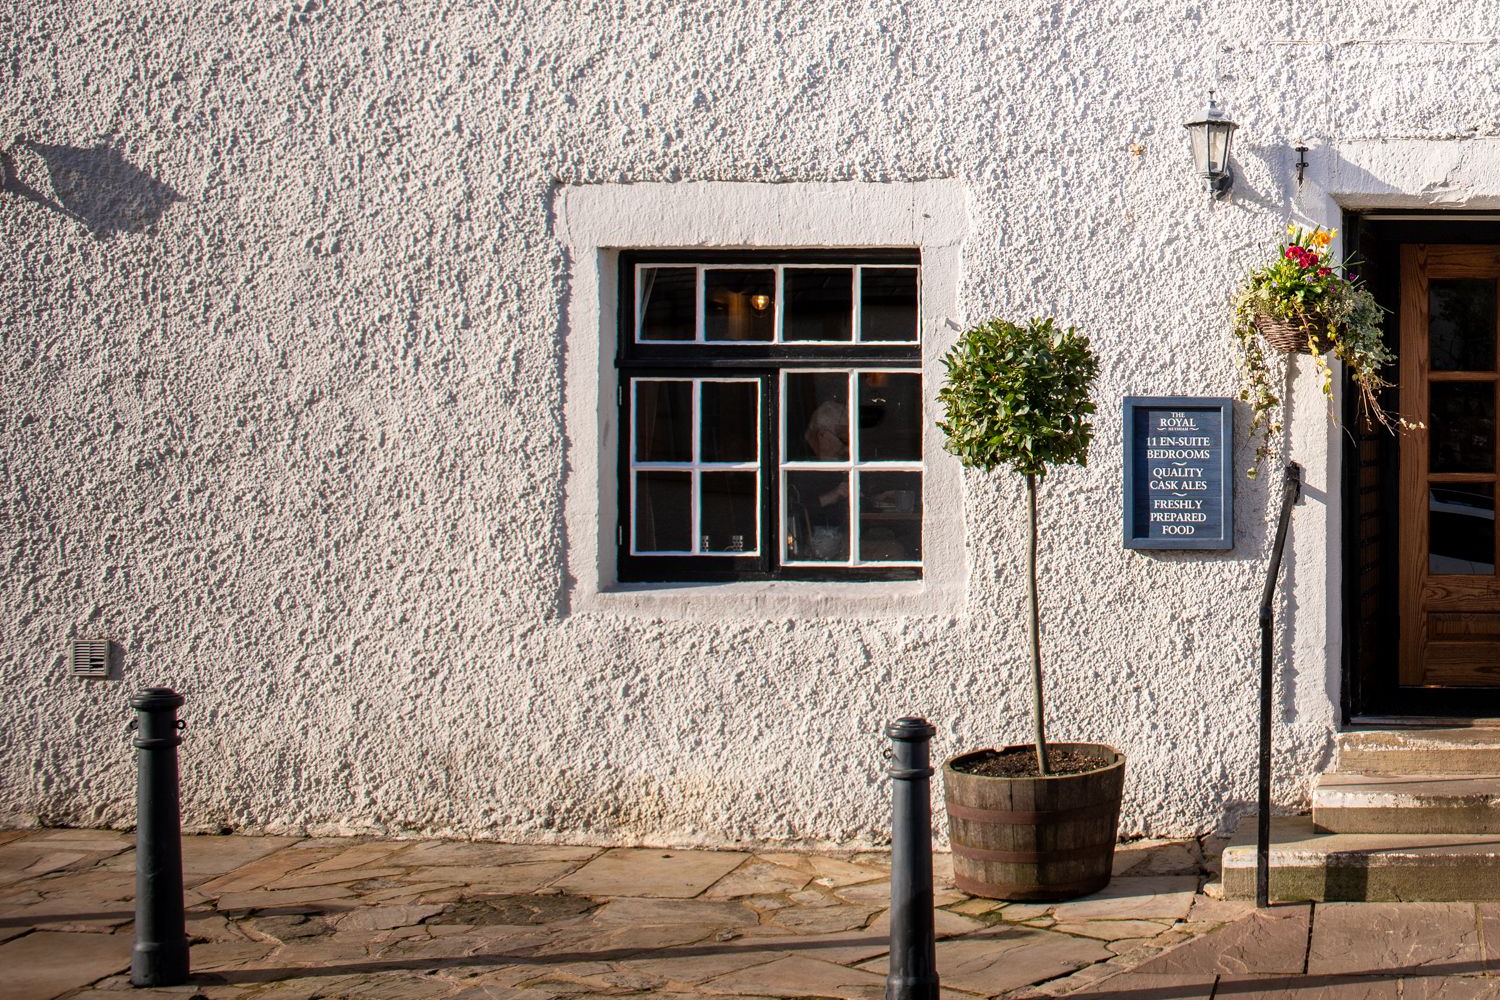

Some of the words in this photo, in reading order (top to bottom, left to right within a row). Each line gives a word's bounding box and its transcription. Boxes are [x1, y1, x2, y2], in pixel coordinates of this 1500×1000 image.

[1160, 418, 1196, 427] ROYAL
[1147, 437, 1158, 446] 11
[1159, 437, 1211, 446] EN-SUITE
[1147, 449, 1210, 459] BEDROOMS
[1153, 467, 1204, 479] QUALITY
[1150, 480, 1179, 490] CASK
[1181, 480, 1207, 490] ALES
[1154, 500, 1203, 509] FRESHLY
[1150, 513, 1207, 522] PREPARED
[1162, 525, 1195, 535] FOOD
